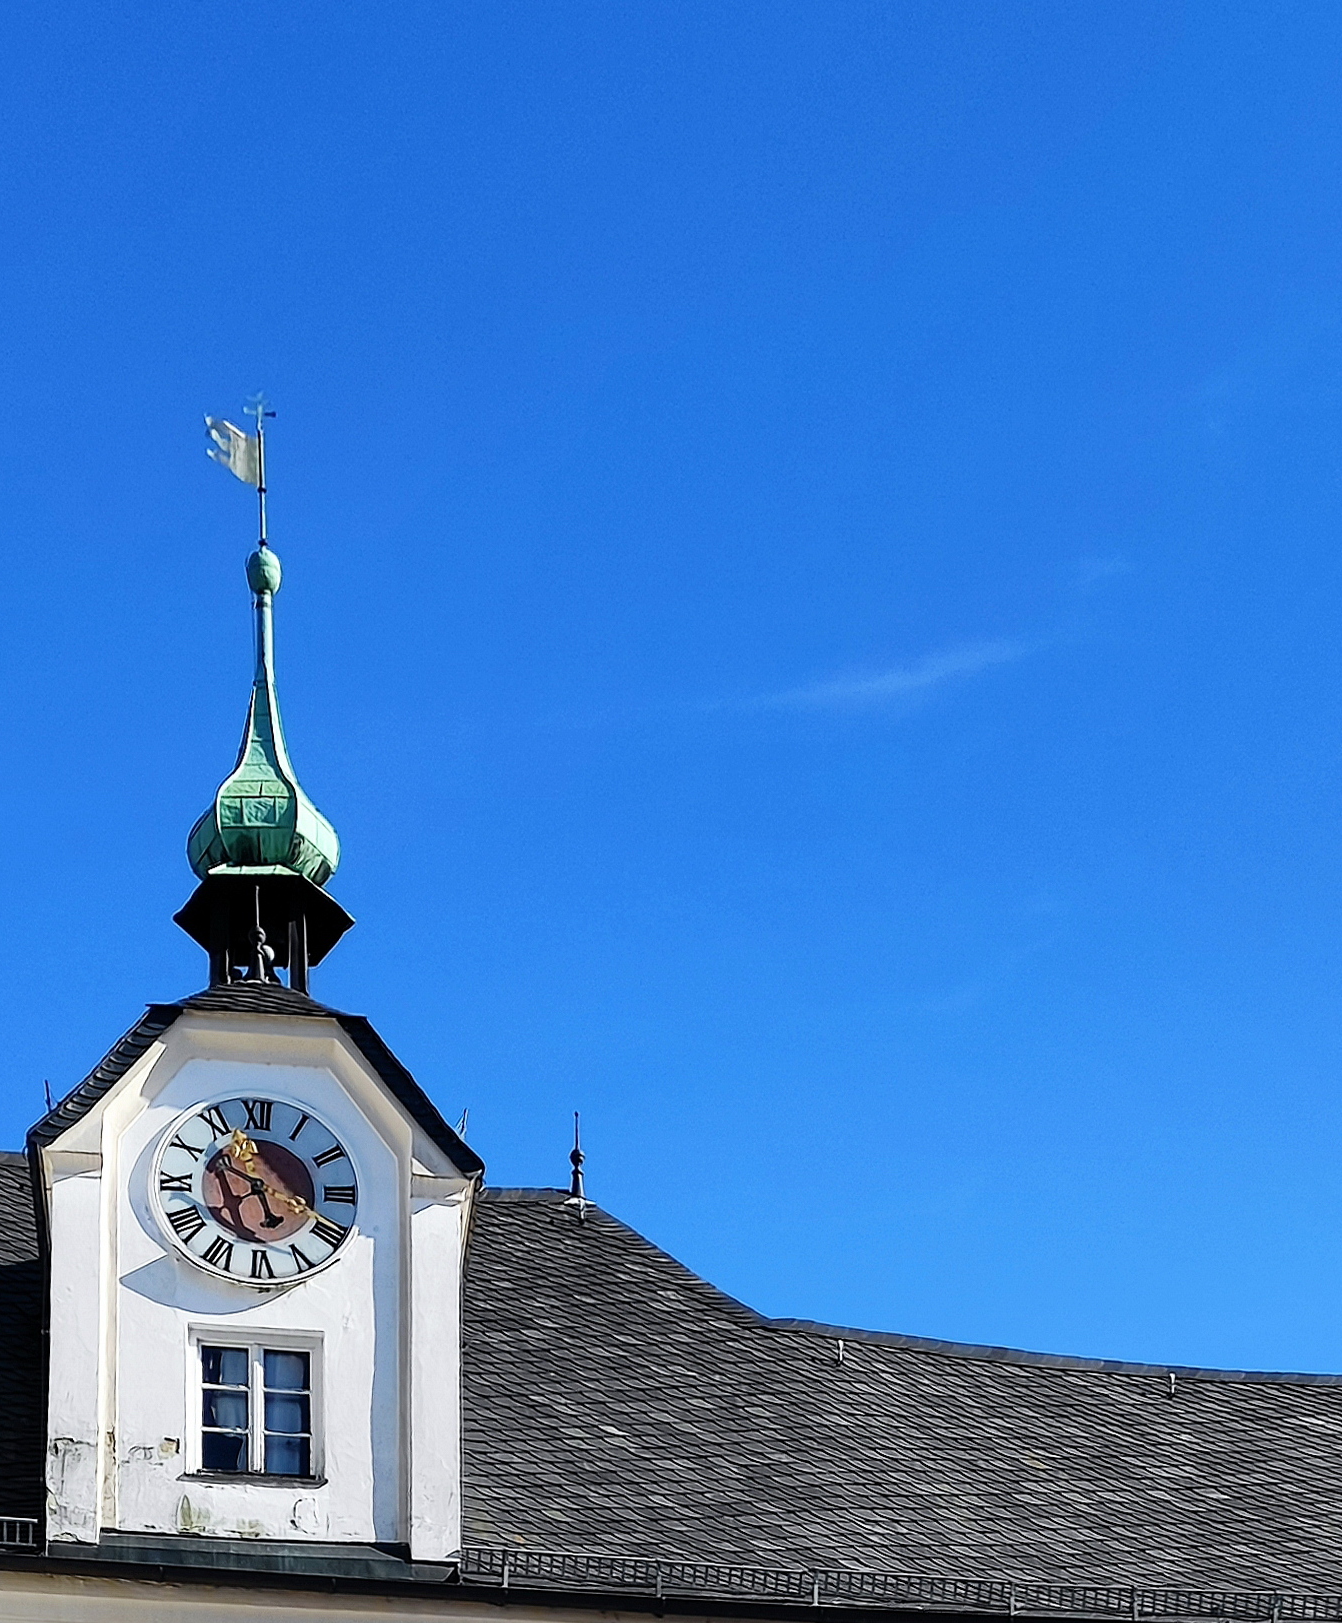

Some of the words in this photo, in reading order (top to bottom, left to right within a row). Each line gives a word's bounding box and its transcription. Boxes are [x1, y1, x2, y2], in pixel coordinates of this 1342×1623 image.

[198, 1105, 232, 1141] XI
[242, 1100, 274, 1131] XII
[289, 1114, 310, 1141] I
[170, 1135, 205, 1162] X
[312, 1144, 346, 1168] II
[159, 1171, 193, 1193] IX
[323, 1184, 356, 1206] III
[167, 1205, 207, 1245] VIII
[201, 1235, 234, 1272] VII
[250, 1249, 276, 1279] VI
[289, 1243, 317, 1274] V
